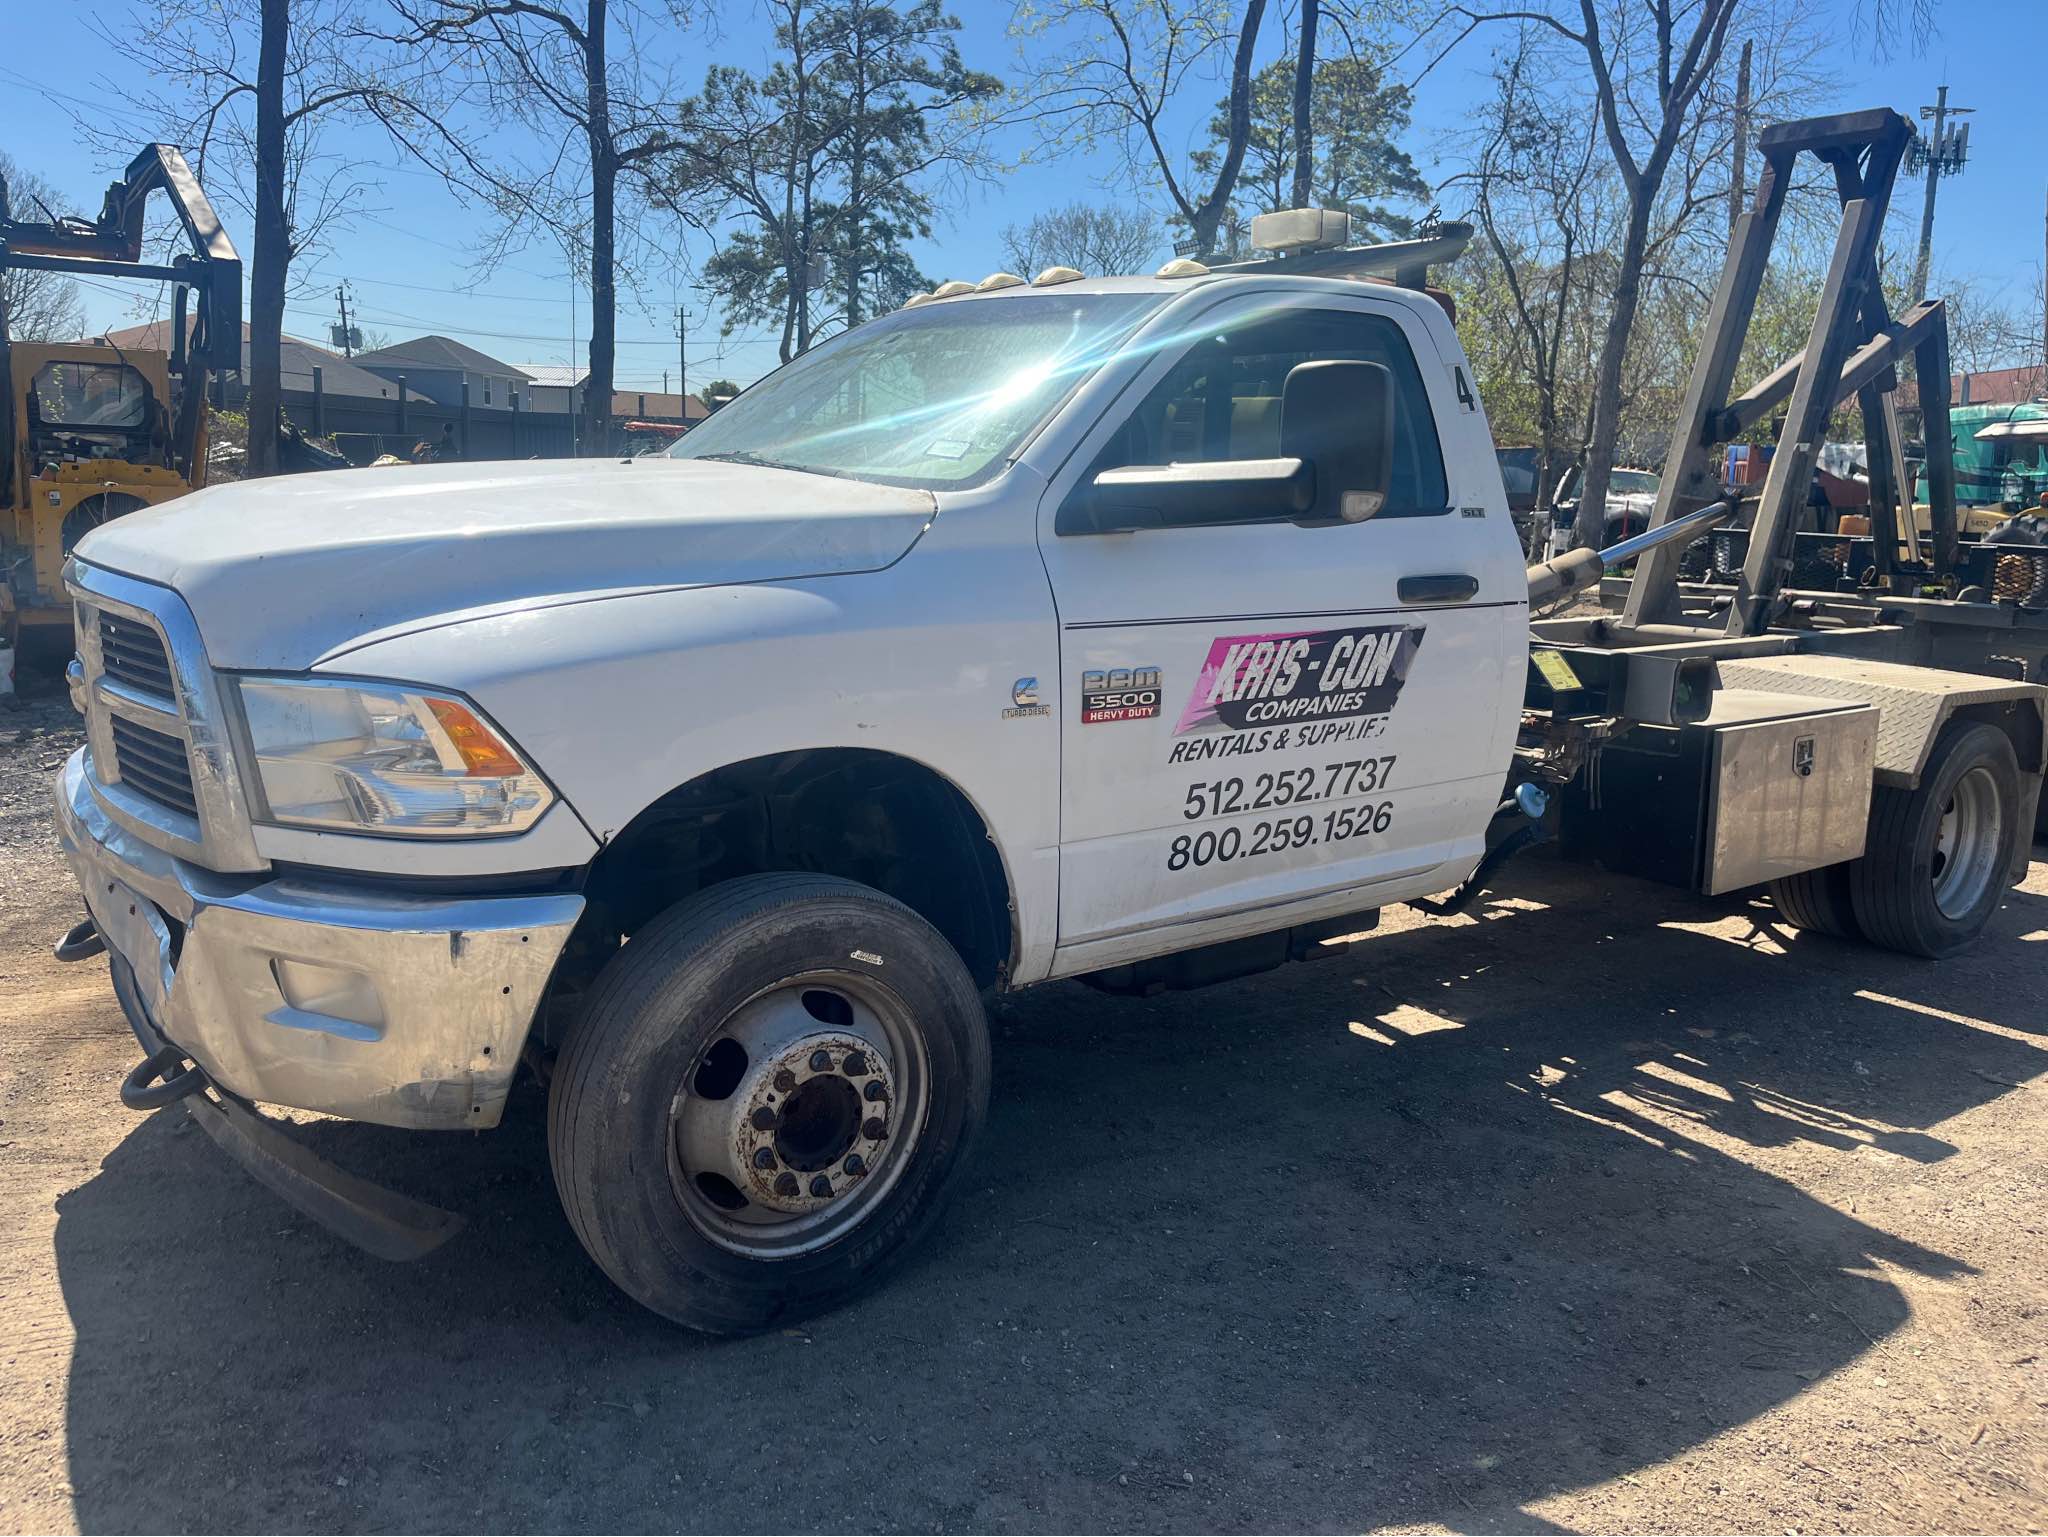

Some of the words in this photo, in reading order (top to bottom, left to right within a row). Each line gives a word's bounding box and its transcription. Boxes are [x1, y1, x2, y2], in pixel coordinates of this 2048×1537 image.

[1454, 366, 1475, 411] 4
[1083, 667, 1162, 692] RAM
[1205, 631, 1403, 703] KRIS-CON
[1089, 691, 1156, 710] 5500
[1090, 709, 1124, 721] HEAVY
[1128, 707, 1155, 718] DUTY
[1245, 692, 1367, 722] COMPANIES
[1168, 730, 1269, 763] RENTALS
[1272, 728, 1290, 751] &
[1183, 755, 1397, 820] 512.252.7737
[1167, 801, 1394, 871] 800.259.1526
